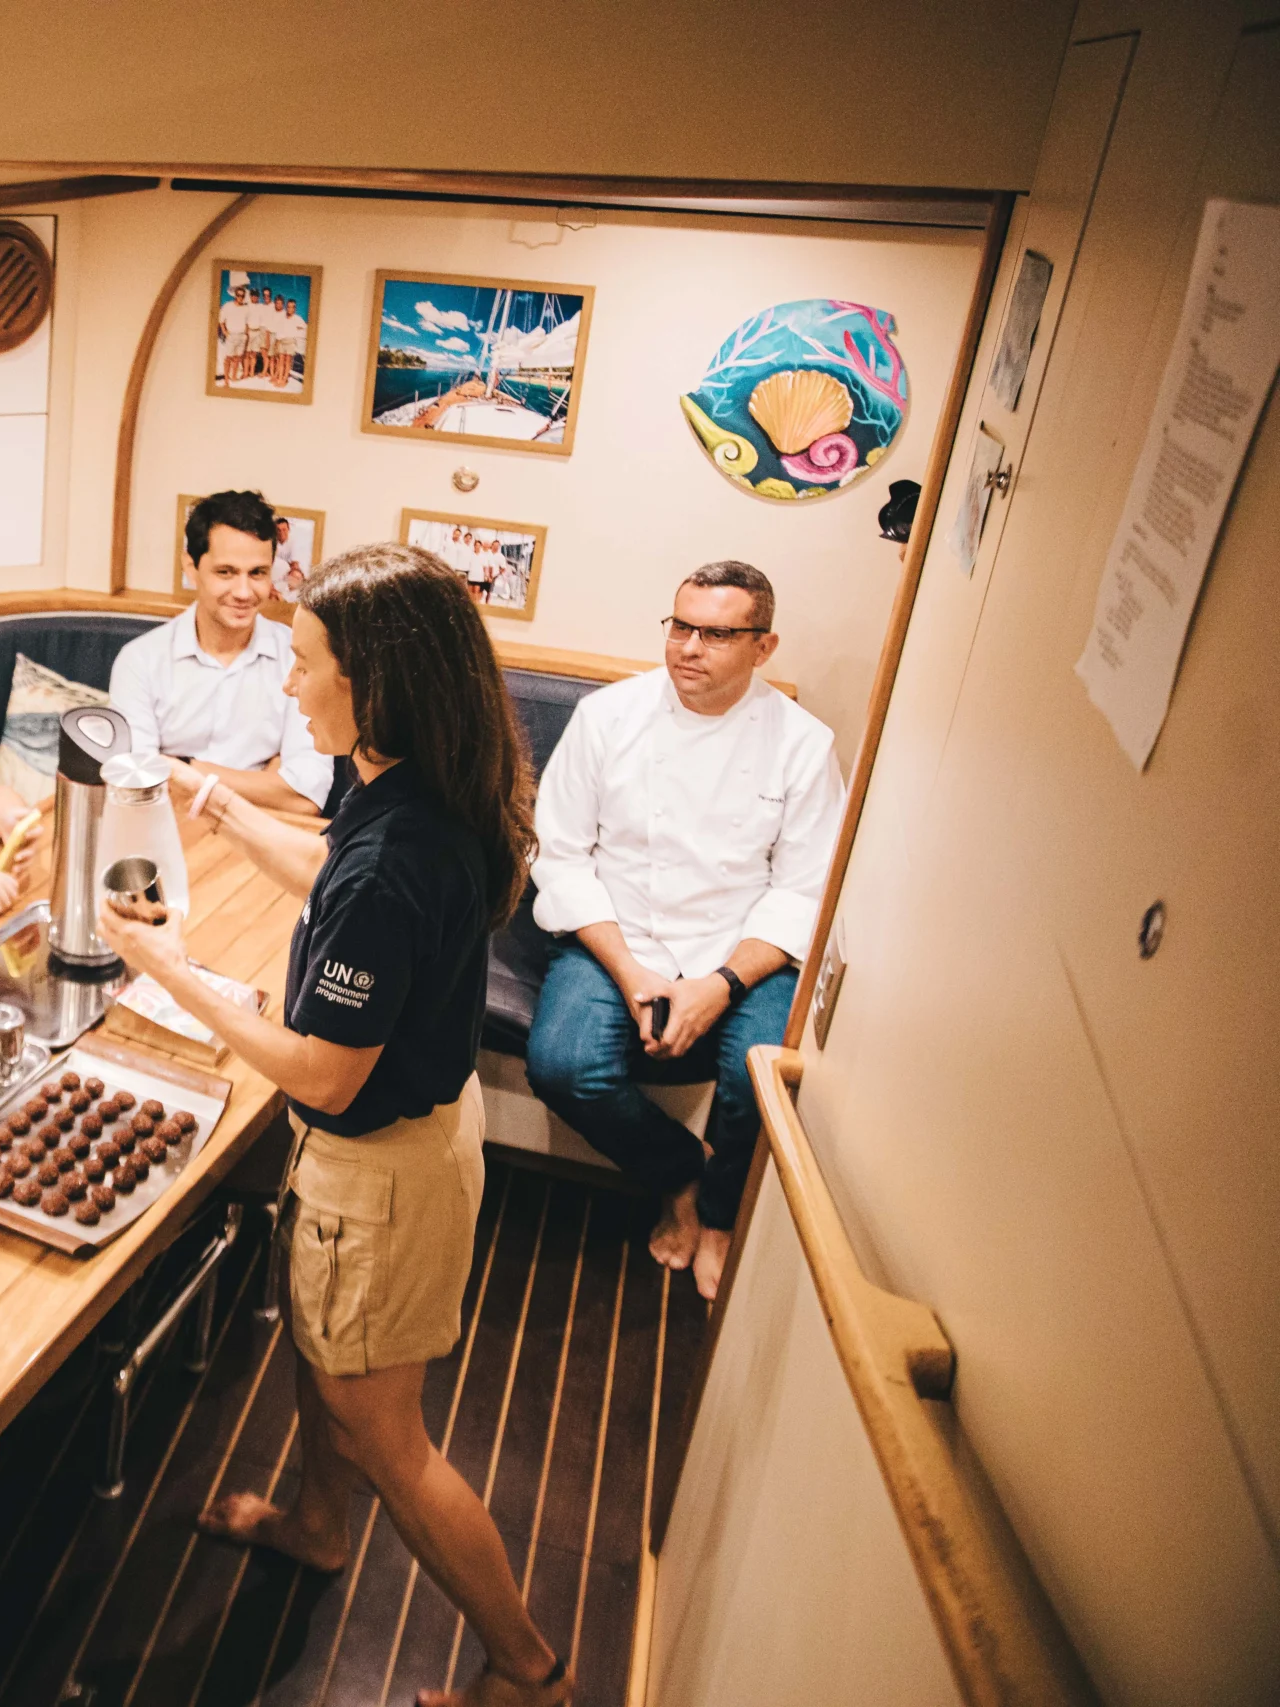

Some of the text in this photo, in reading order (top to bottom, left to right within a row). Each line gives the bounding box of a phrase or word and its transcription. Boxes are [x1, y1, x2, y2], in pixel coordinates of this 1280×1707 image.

[323, 960, 353, 985] UN
[315, 986, 363, 1009] programme
[319, 978, 370, 1001] environment
